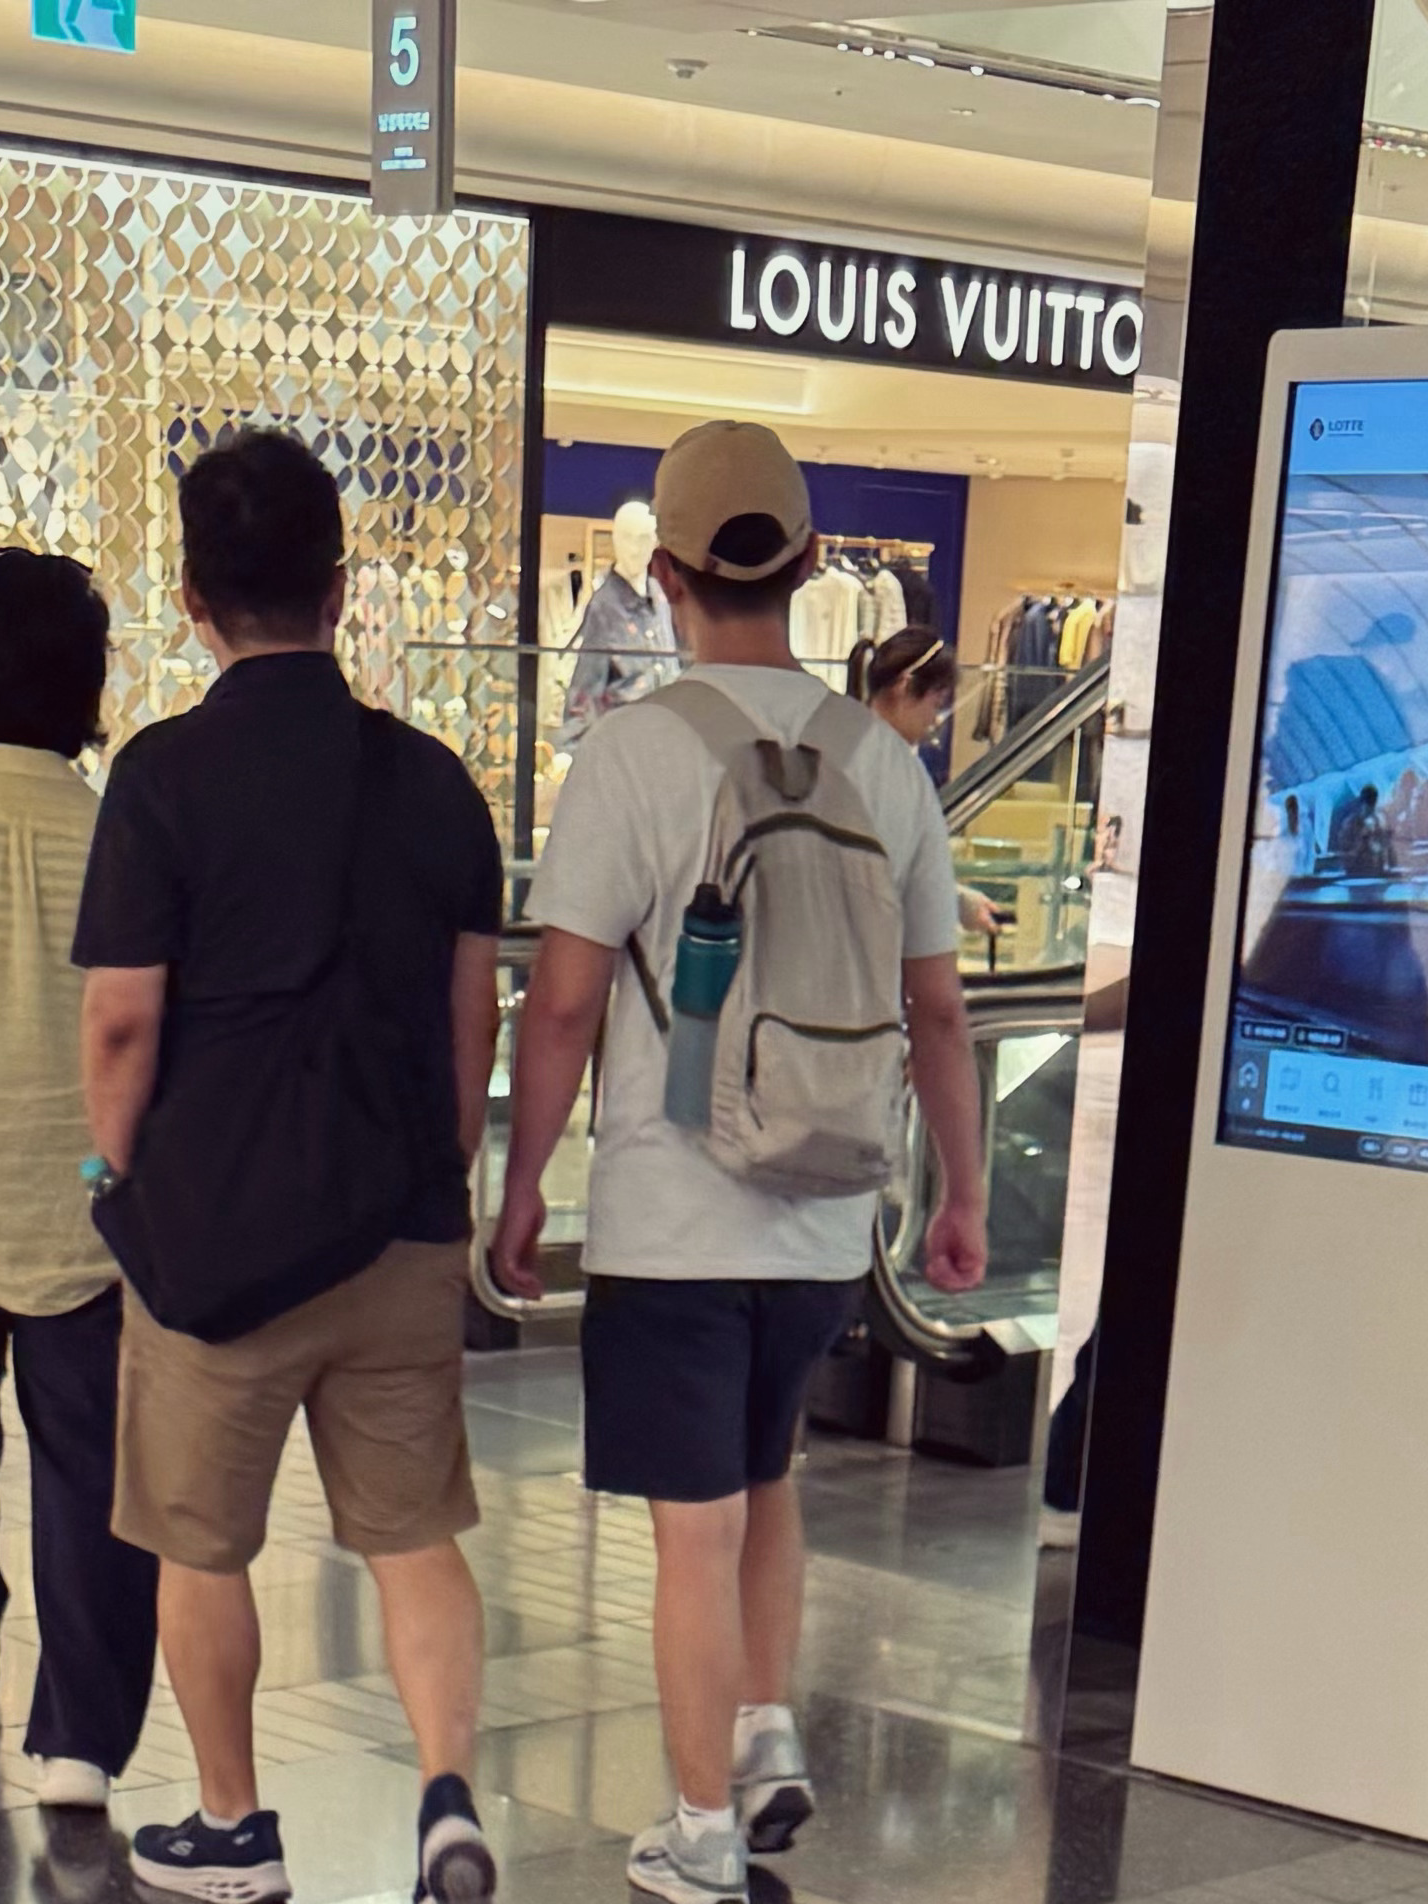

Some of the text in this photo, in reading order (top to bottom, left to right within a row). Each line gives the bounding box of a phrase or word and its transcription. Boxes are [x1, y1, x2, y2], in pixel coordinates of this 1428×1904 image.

[389, 15, 420, 86] 5
[728, 248, 1143, 377] LOUIS VUITTO
